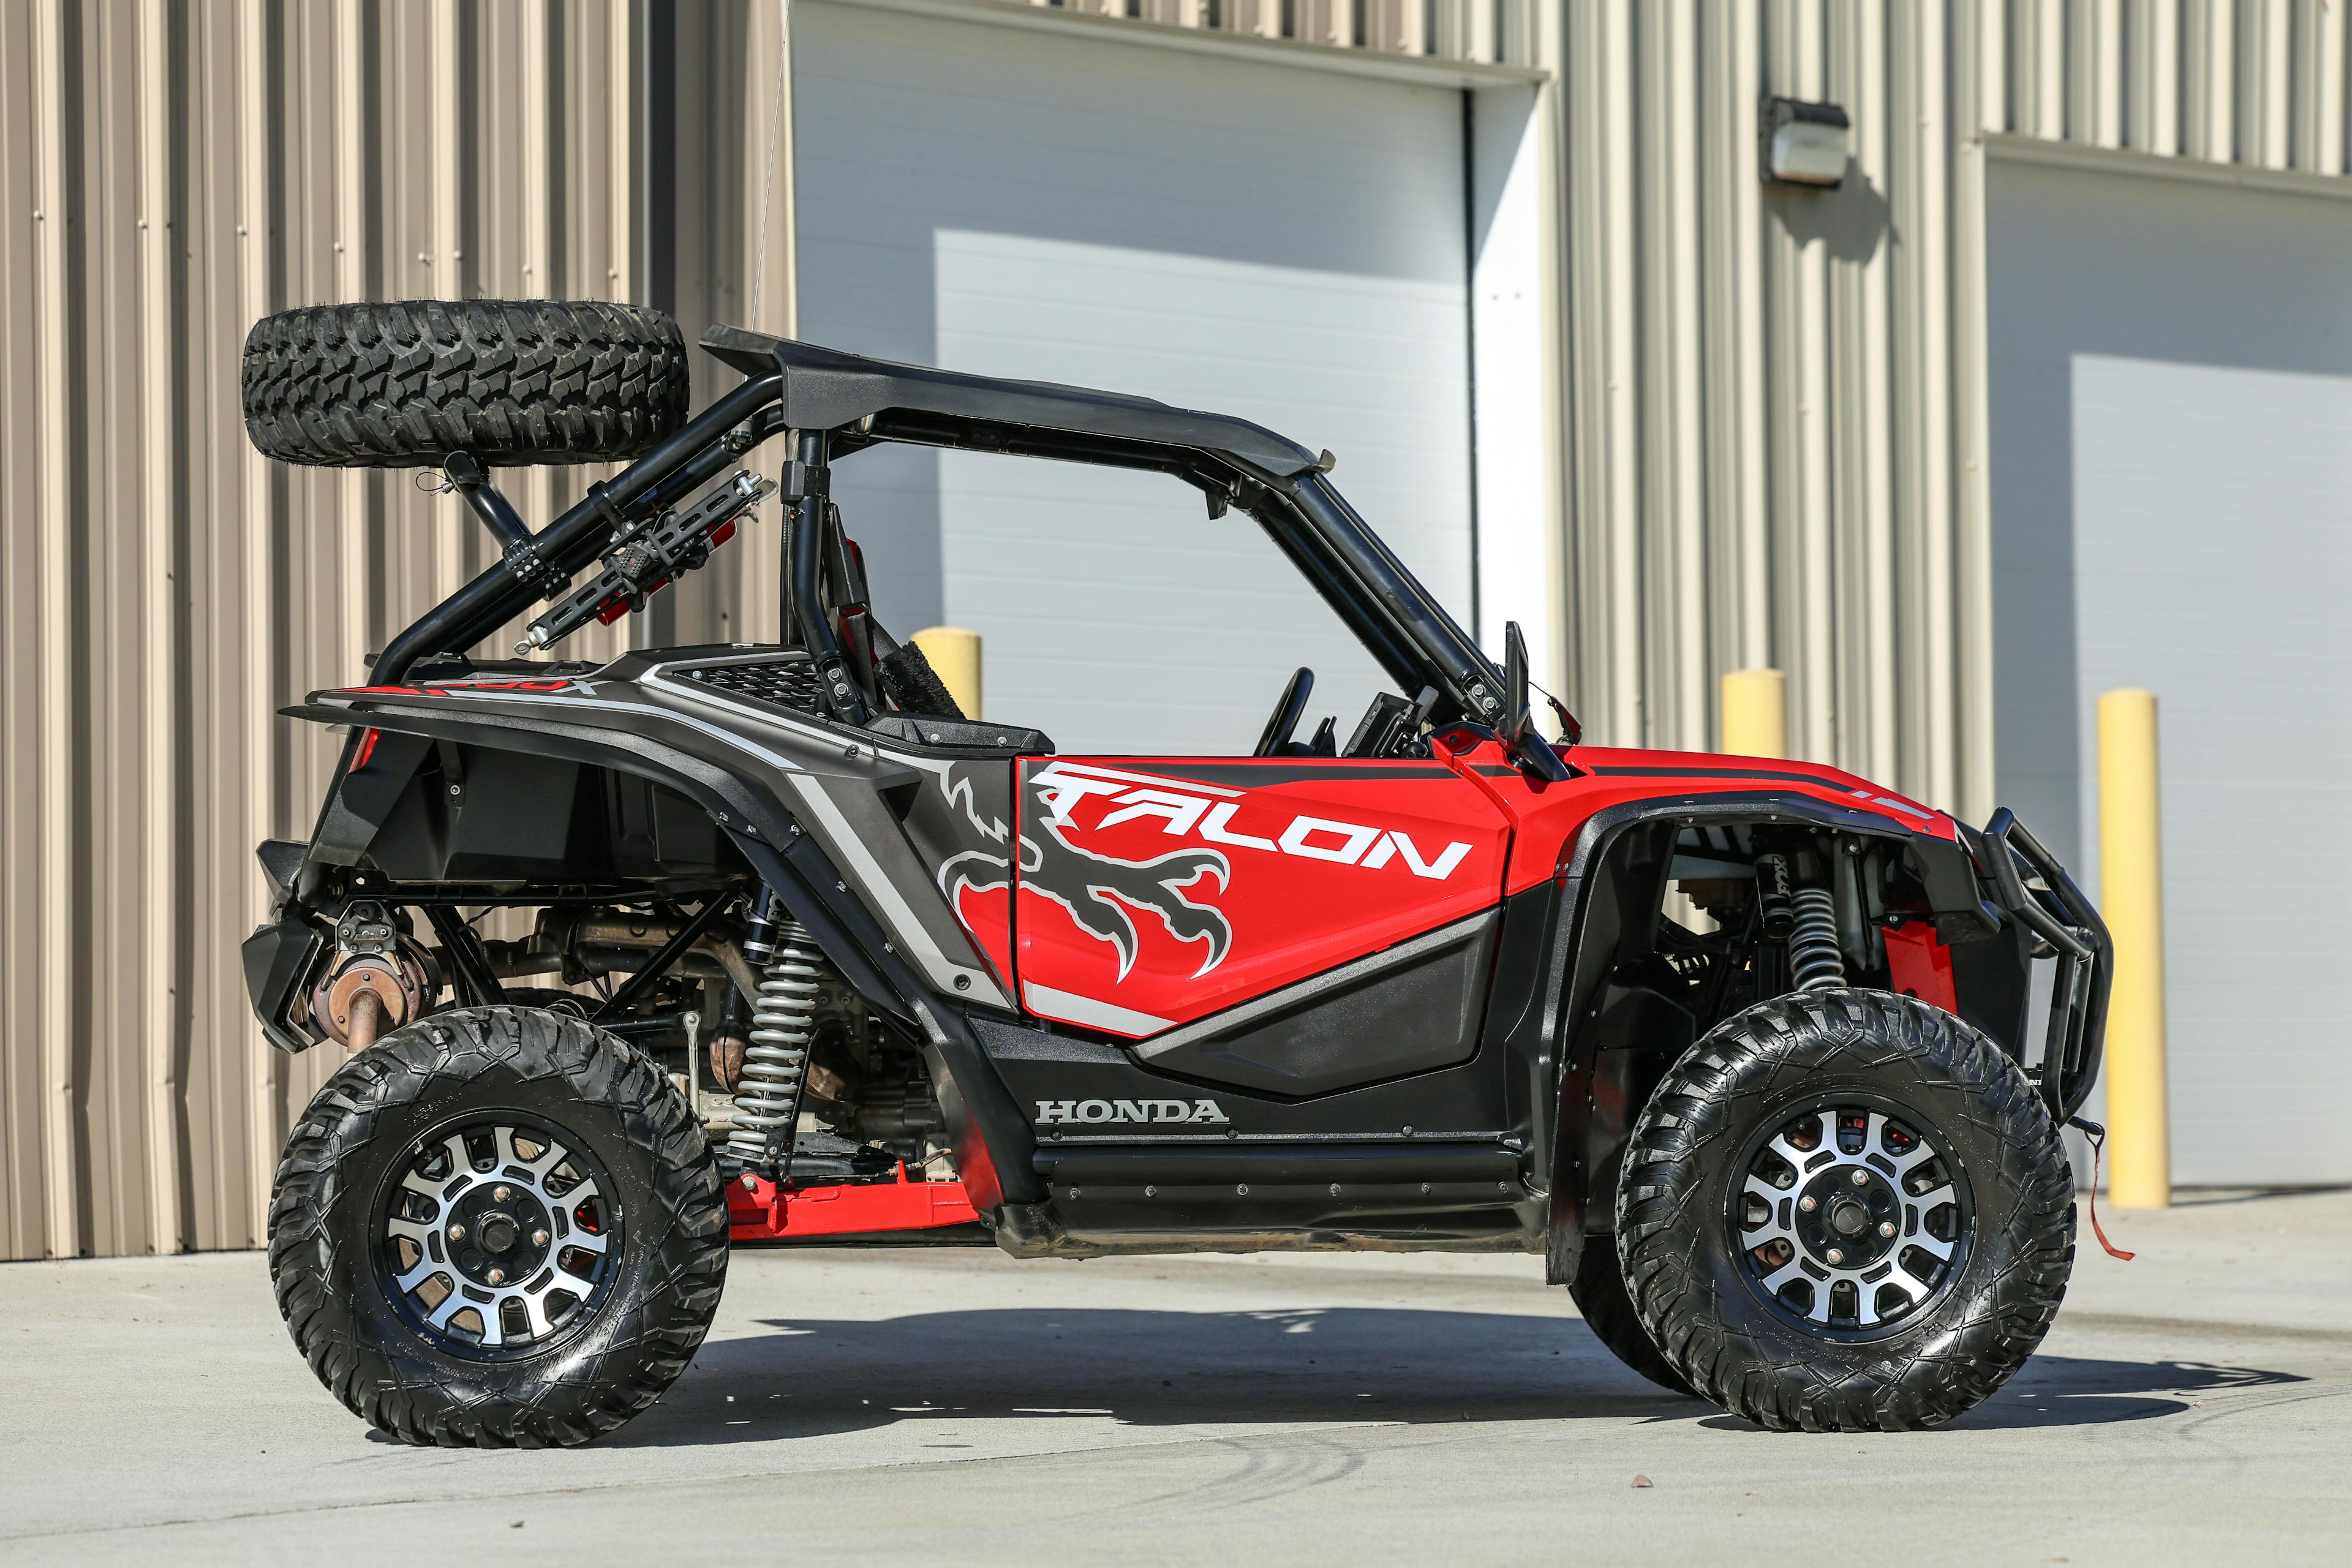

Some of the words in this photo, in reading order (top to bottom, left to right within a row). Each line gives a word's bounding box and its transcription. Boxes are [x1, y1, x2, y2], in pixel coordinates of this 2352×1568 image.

[1028, 771, 1473, 880] TALON
[1773, 857, 1791, 897] FOX
[766, 891, 785, 921] FO
[1035, 1099, 1230, 1123] HONDA
